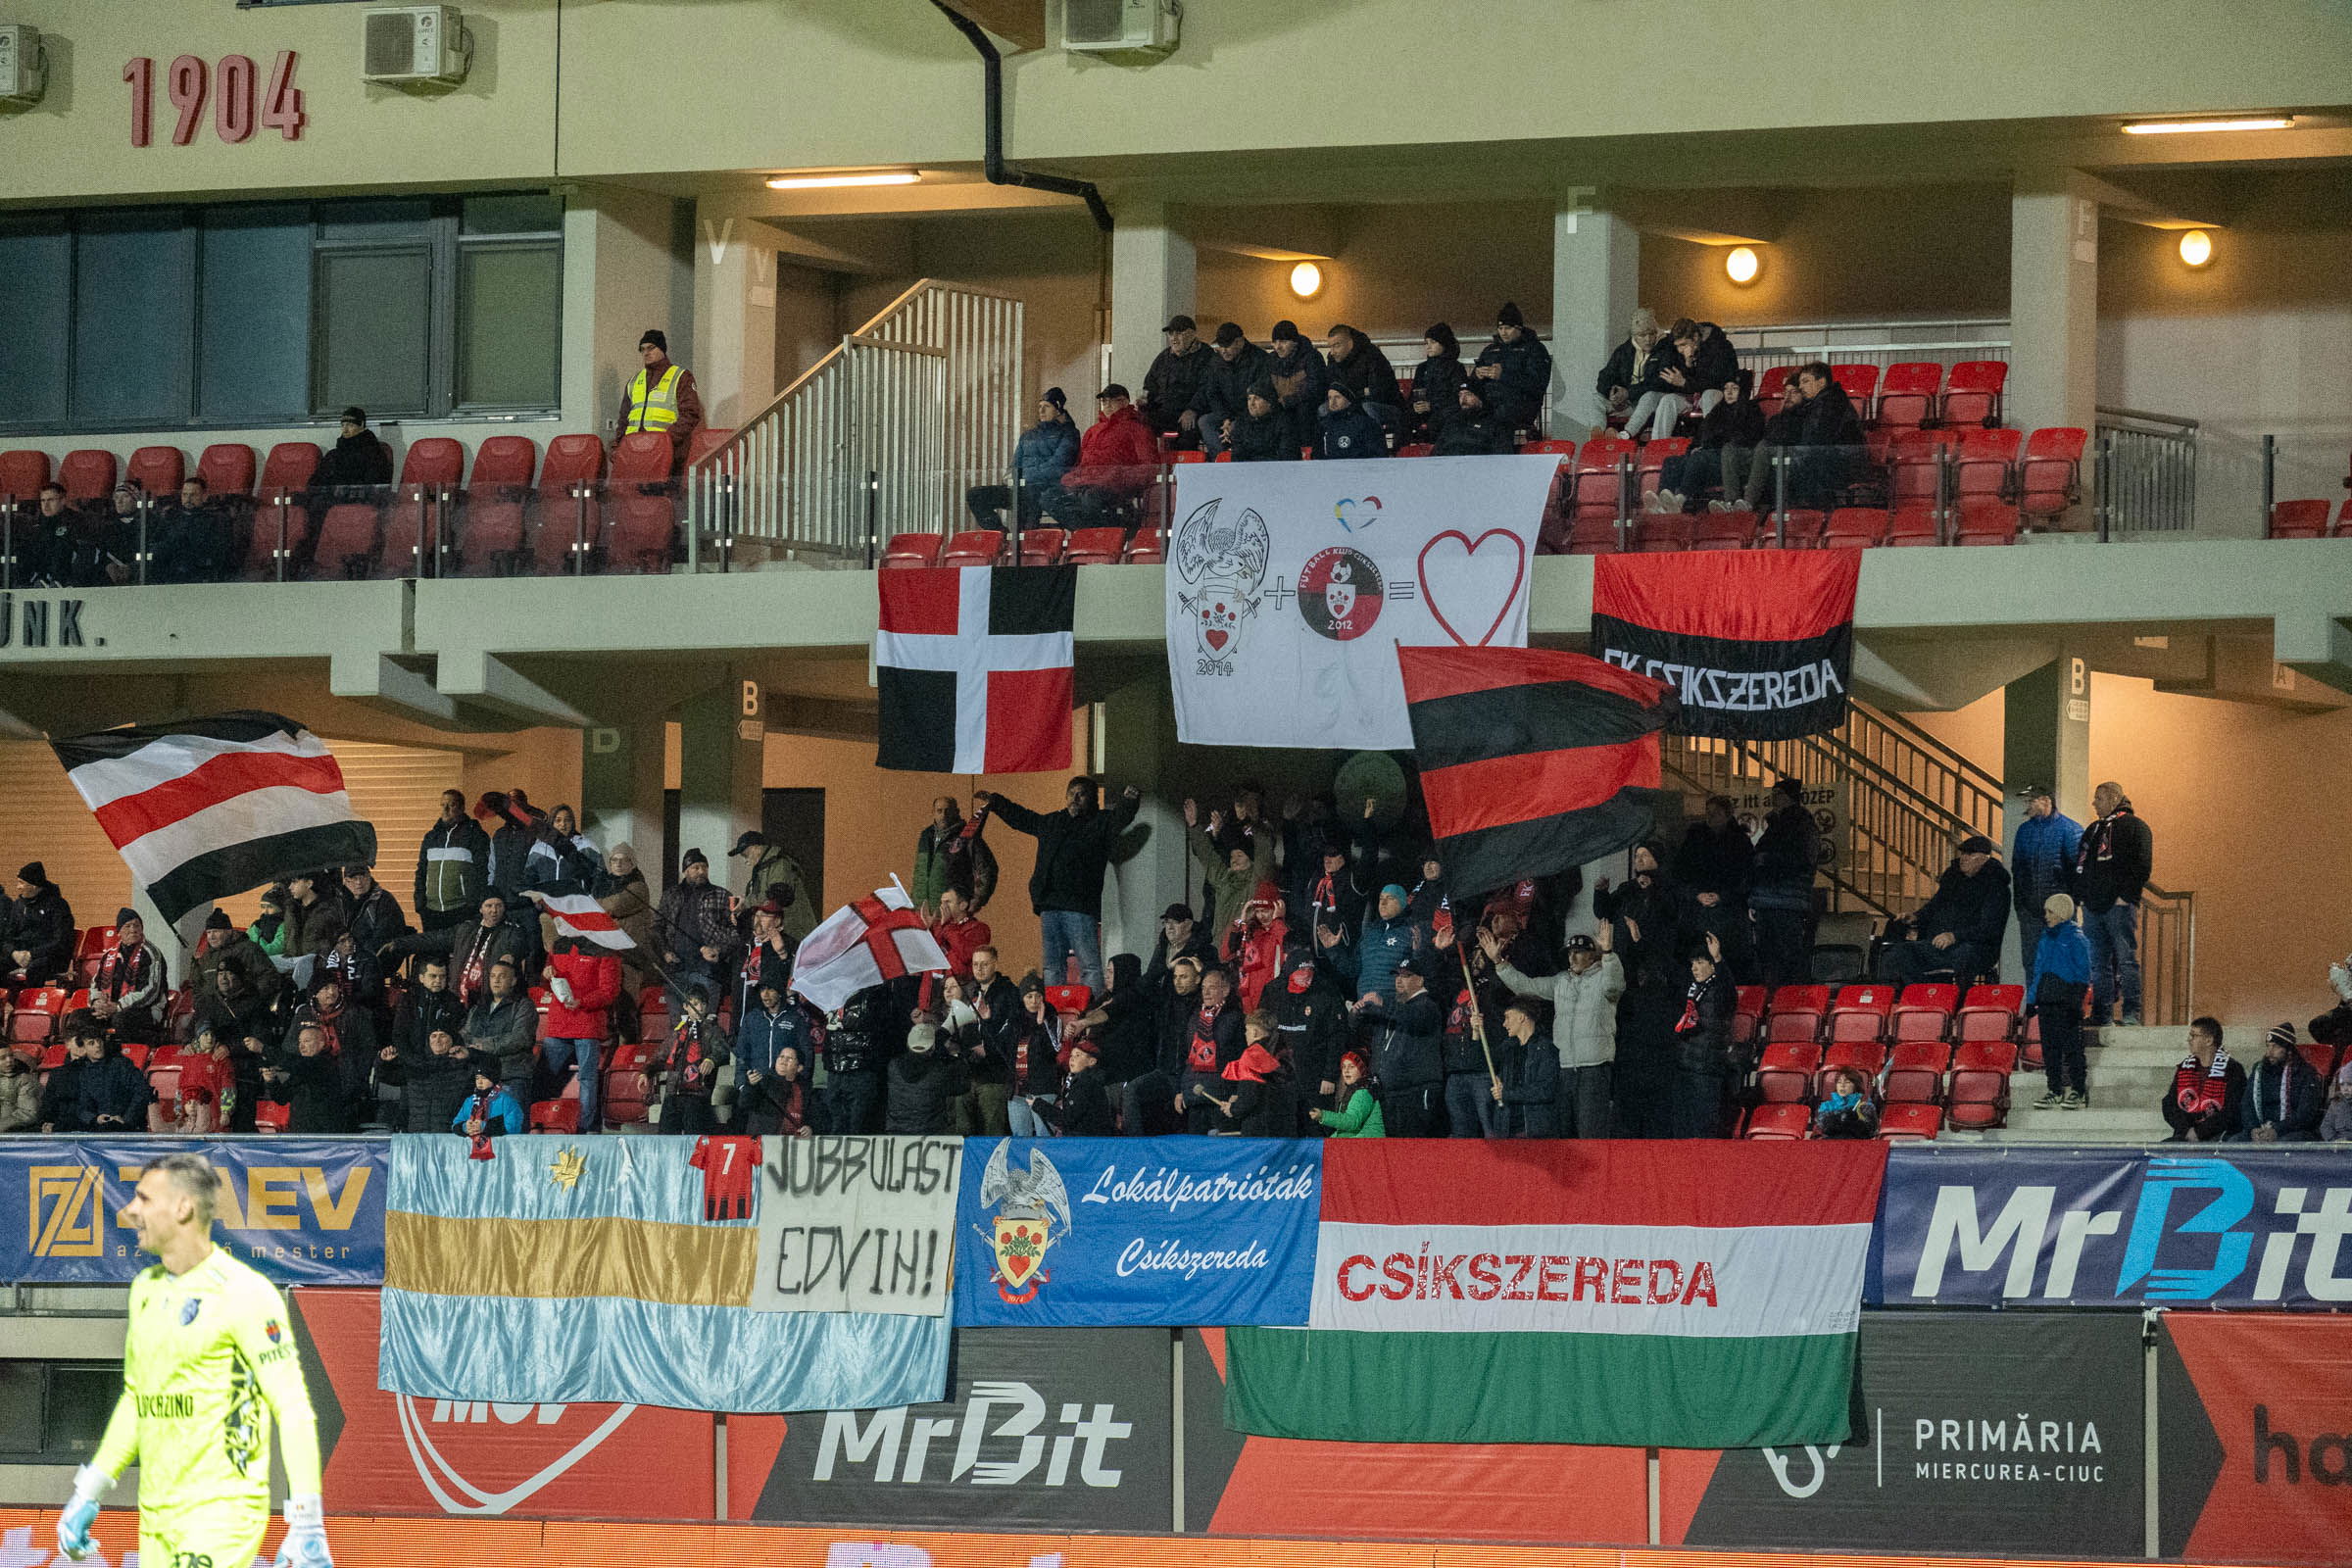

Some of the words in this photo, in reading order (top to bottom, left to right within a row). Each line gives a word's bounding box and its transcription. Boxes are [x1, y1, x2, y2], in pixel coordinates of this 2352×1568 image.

[122, 50, 306, 148] 1904
[1568, 185, 1595, 234] F
[703, 218, 734, 266] V
[1327, 619, 1353, 630] 2012
[1196, 658, 1234, 677] 2014
[2072, 658, 2085, 695] B
[743, 680, 759, 716] B
[592, 728, 620, 754] D
[721, 1143, 737, 1175] 7
[1081, 1163, 1317, 1212] Lokálpatrióták
[1912, 1157, 2352, 1301] MrBit
[252, 1244, 350, 1259] mester
[1115, 1236, 1271, 1277] Csíkszereda
[1337, 1241, 1718, 1308] CSÍKSZEREDA
[812, 1381, 1133, 1489] MrBit
[1916, 1413, 2102, 1454] PRIMĂRIA
[1916, 1462, 2105, 1484] MIERCUREA-CIUC
